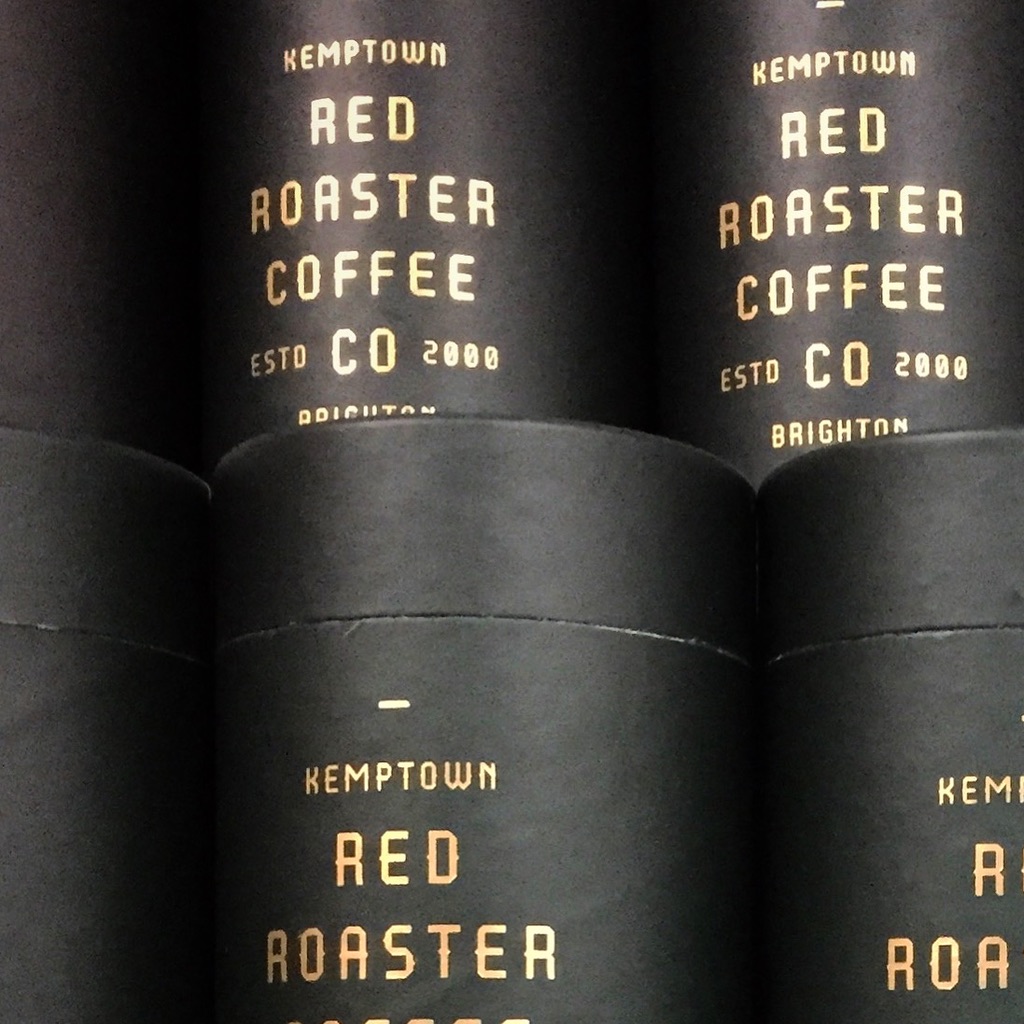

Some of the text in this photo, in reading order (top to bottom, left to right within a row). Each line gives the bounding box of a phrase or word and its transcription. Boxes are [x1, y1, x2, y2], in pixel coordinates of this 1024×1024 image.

[284, 40, 446, 72] KEMPTOWN
[753, 51, 915, 85] KEMPTOWN
[310, 96, 415, 145] RED
[781, 108, 886, 159] RED
[251, 173, 495, 234] ROASTER
[719, 185, 962, 249] ROASTER
[266, 251, 475, 306] COFFEE
[736, 263, 944, 320] COFFEE
[251, 328, 498, 377] ESTD CO 2000
[721, 342, 967, 392] ESTD CO 2000
[772, 418, 908, 448] BRIGHTON
[306, 762, 496, 794] KEMPTOWN
[335, 830, 459, 886] RED
[268, 924, 555, 982] ROASTER
